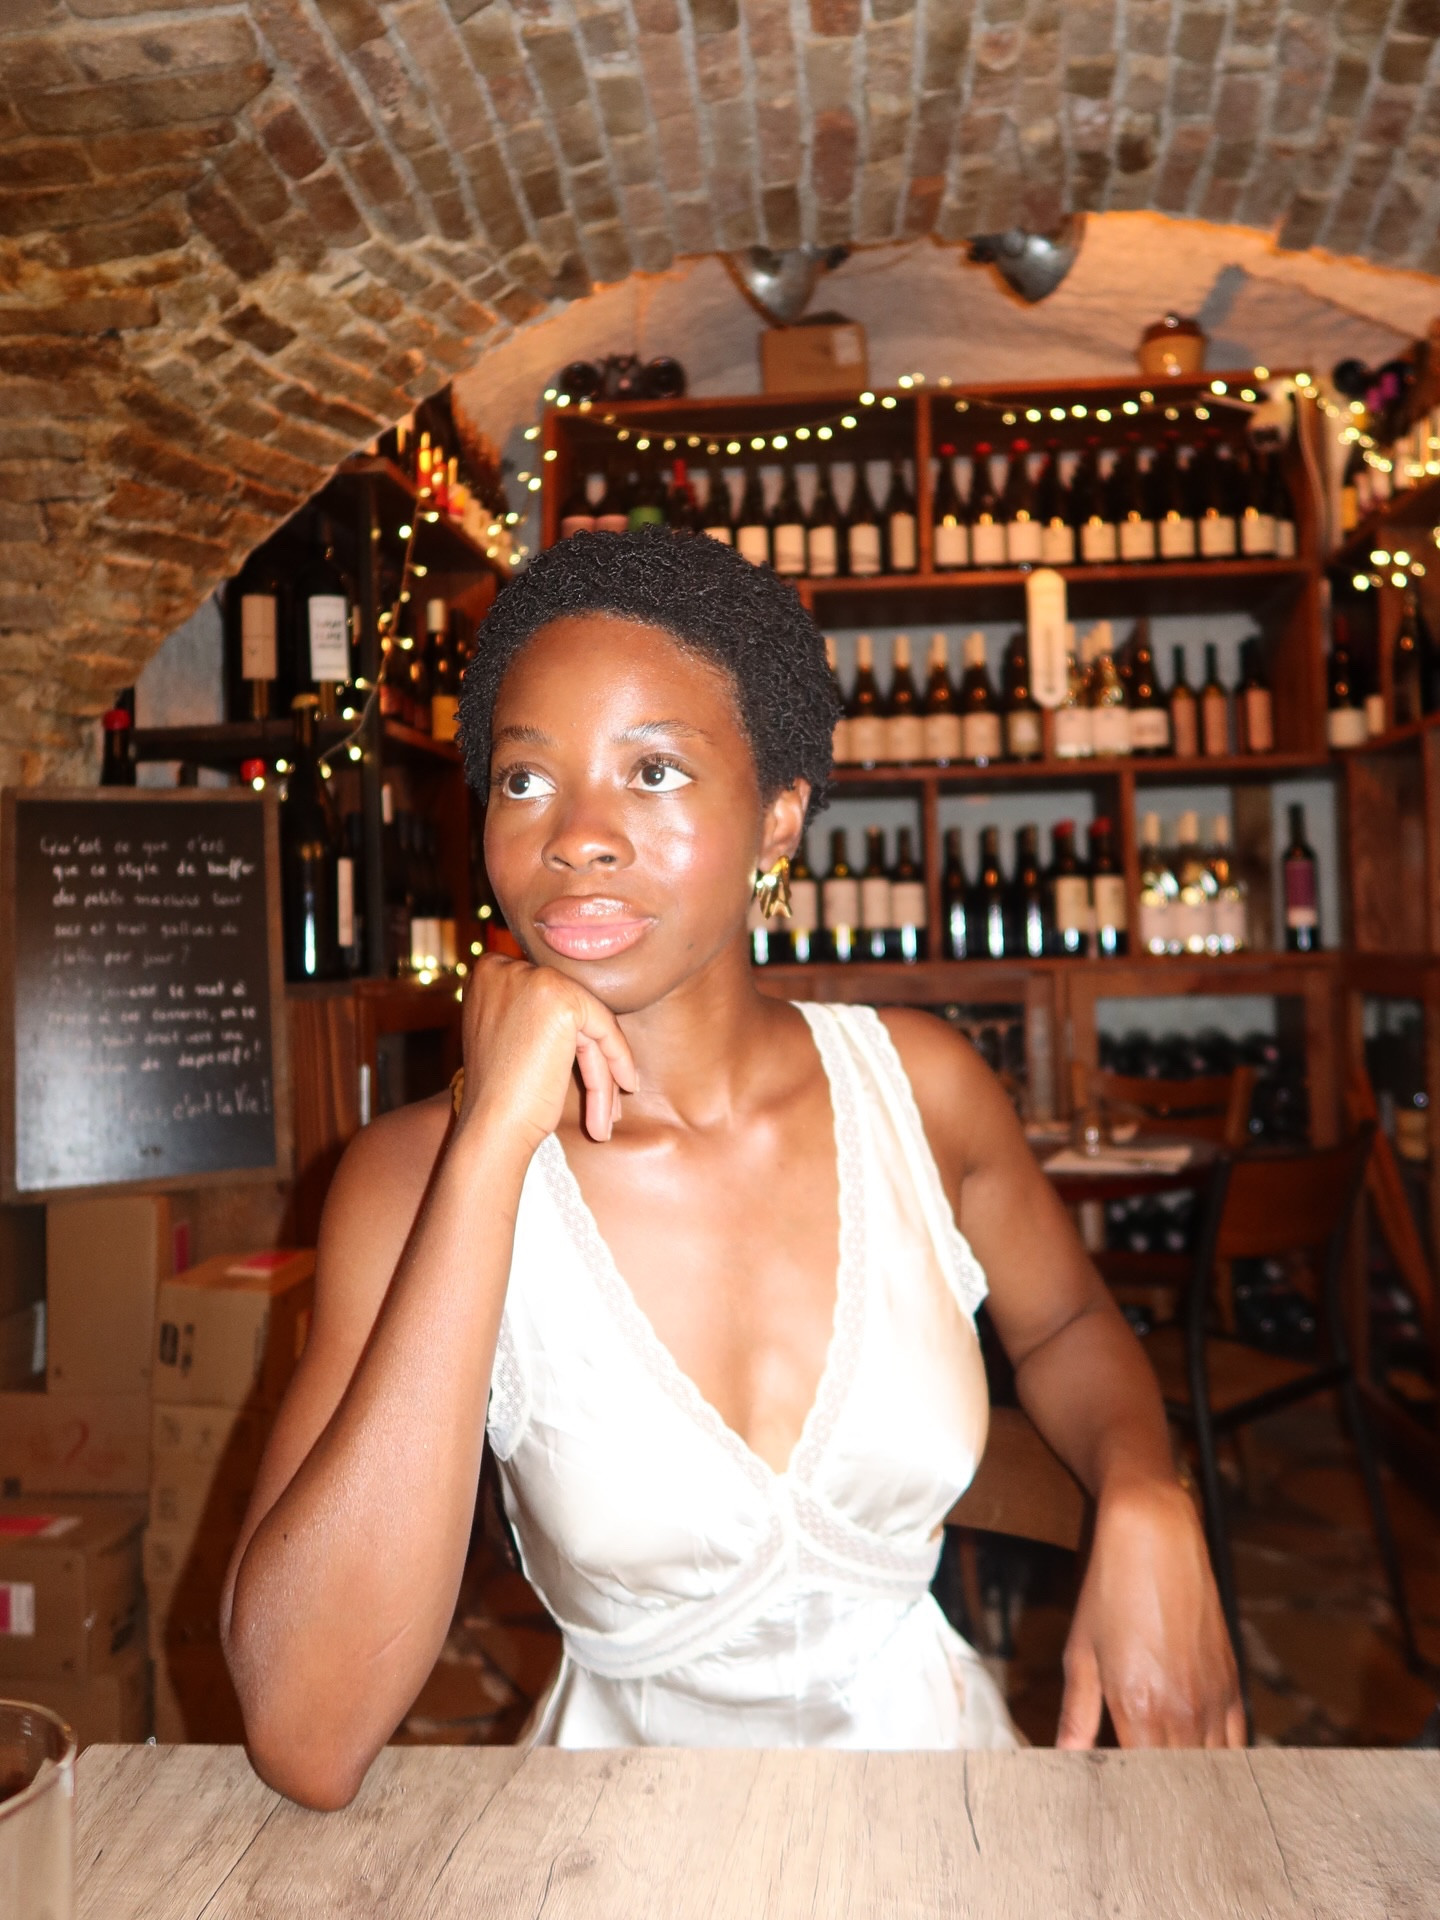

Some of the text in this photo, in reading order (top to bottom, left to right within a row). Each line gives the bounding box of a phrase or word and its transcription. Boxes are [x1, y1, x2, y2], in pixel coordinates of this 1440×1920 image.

[114, 840, 130, 854] ce
[142, 841, 168, 859] que
[52, 857, 254, 883] que ce style de bouffer
[52, 887, 77, 907] des
[104, 951, 133, 967] par
[140, 1055, 161, 1073] de
